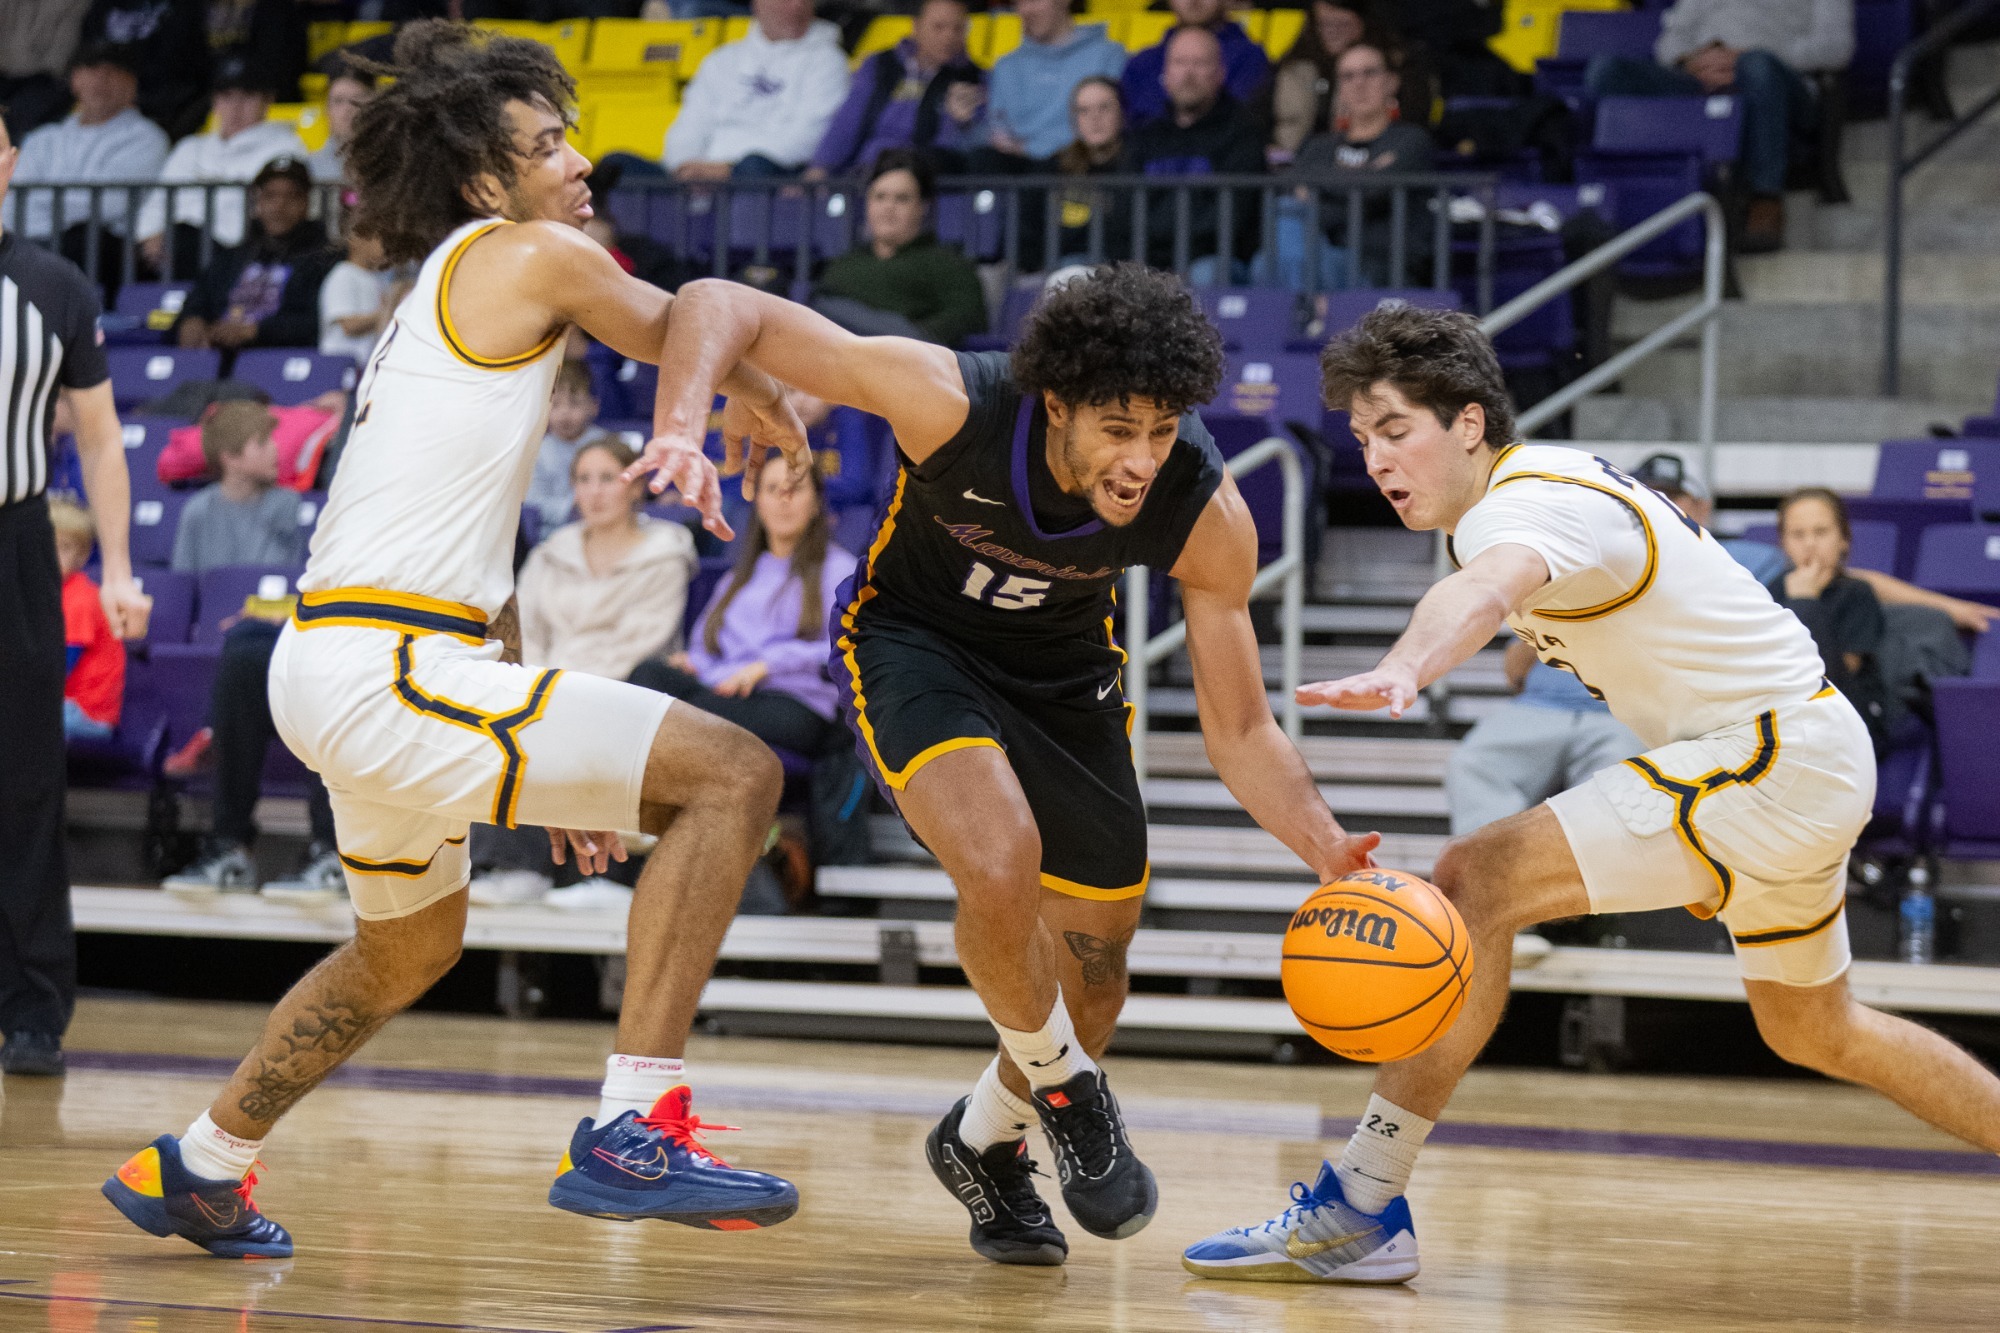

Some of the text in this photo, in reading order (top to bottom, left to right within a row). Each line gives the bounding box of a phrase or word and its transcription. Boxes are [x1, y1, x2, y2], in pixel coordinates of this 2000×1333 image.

[961, 561, 1052, 610] 15
[1291, 906, 1398, 951] Wilson
[1366, 1114, 1400, 1138] 23
